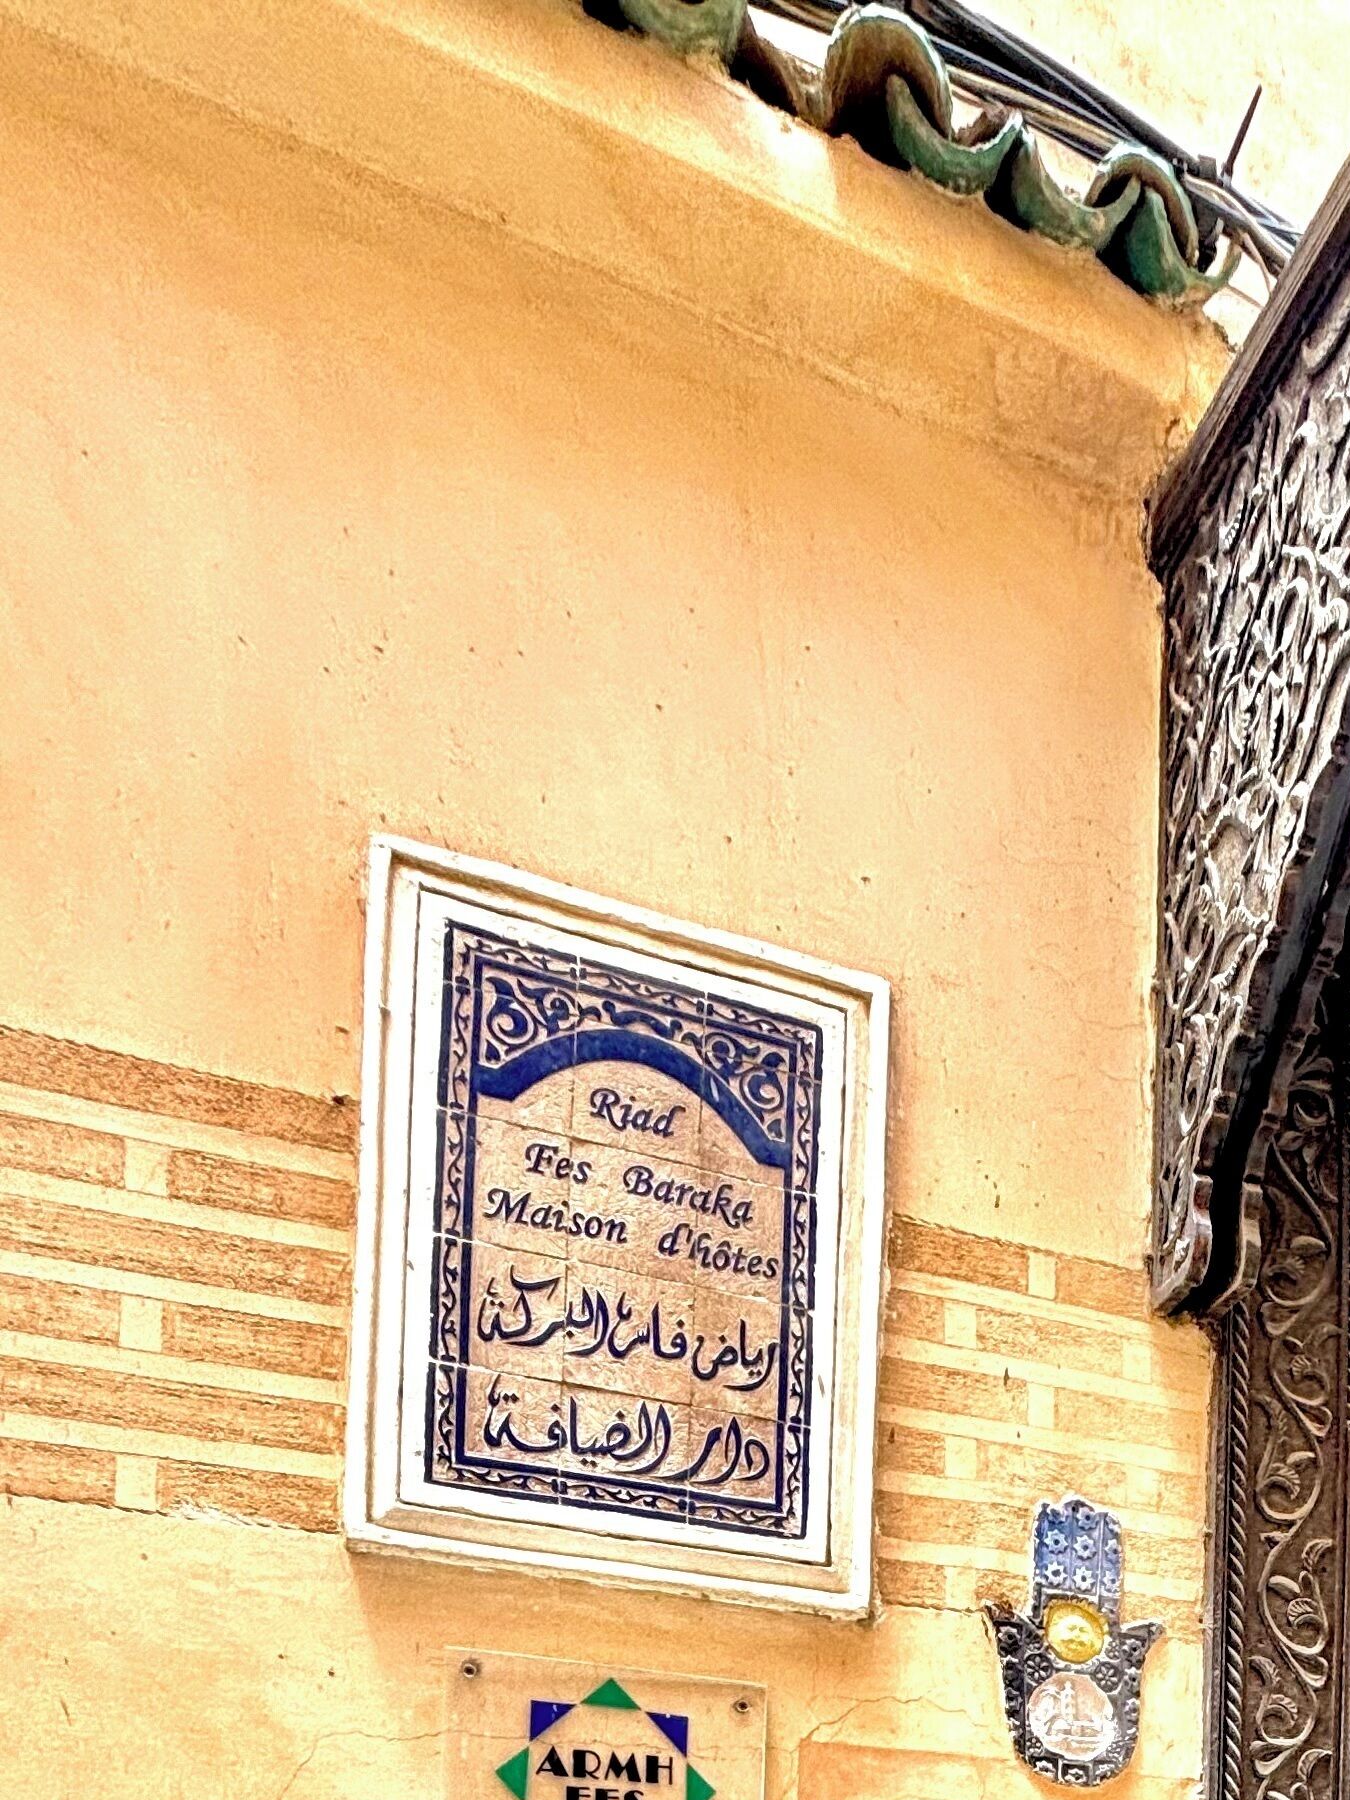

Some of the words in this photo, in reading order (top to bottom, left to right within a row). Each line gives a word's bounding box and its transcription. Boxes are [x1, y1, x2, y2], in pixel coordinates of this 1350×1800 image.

[590, 1088, 686, 1138] Riad
[525, 1142, 592, 1185] Fes
[623, 1165, 753, 1229] Baraka
[484, 1188, 627, 1243] Maison
[658, 1223, 779, 1279] d'hôtes
[477, 1265, 610, 1357] البركة
[607, 1293, 688, 1359] فاس
[691, 1318, 780, 1391] رياض
[483, 1374, 672, 1475] الضيافة
[651, 1416, 771, 1485] دار
[536, 1745, 673, 1785] ARMH
